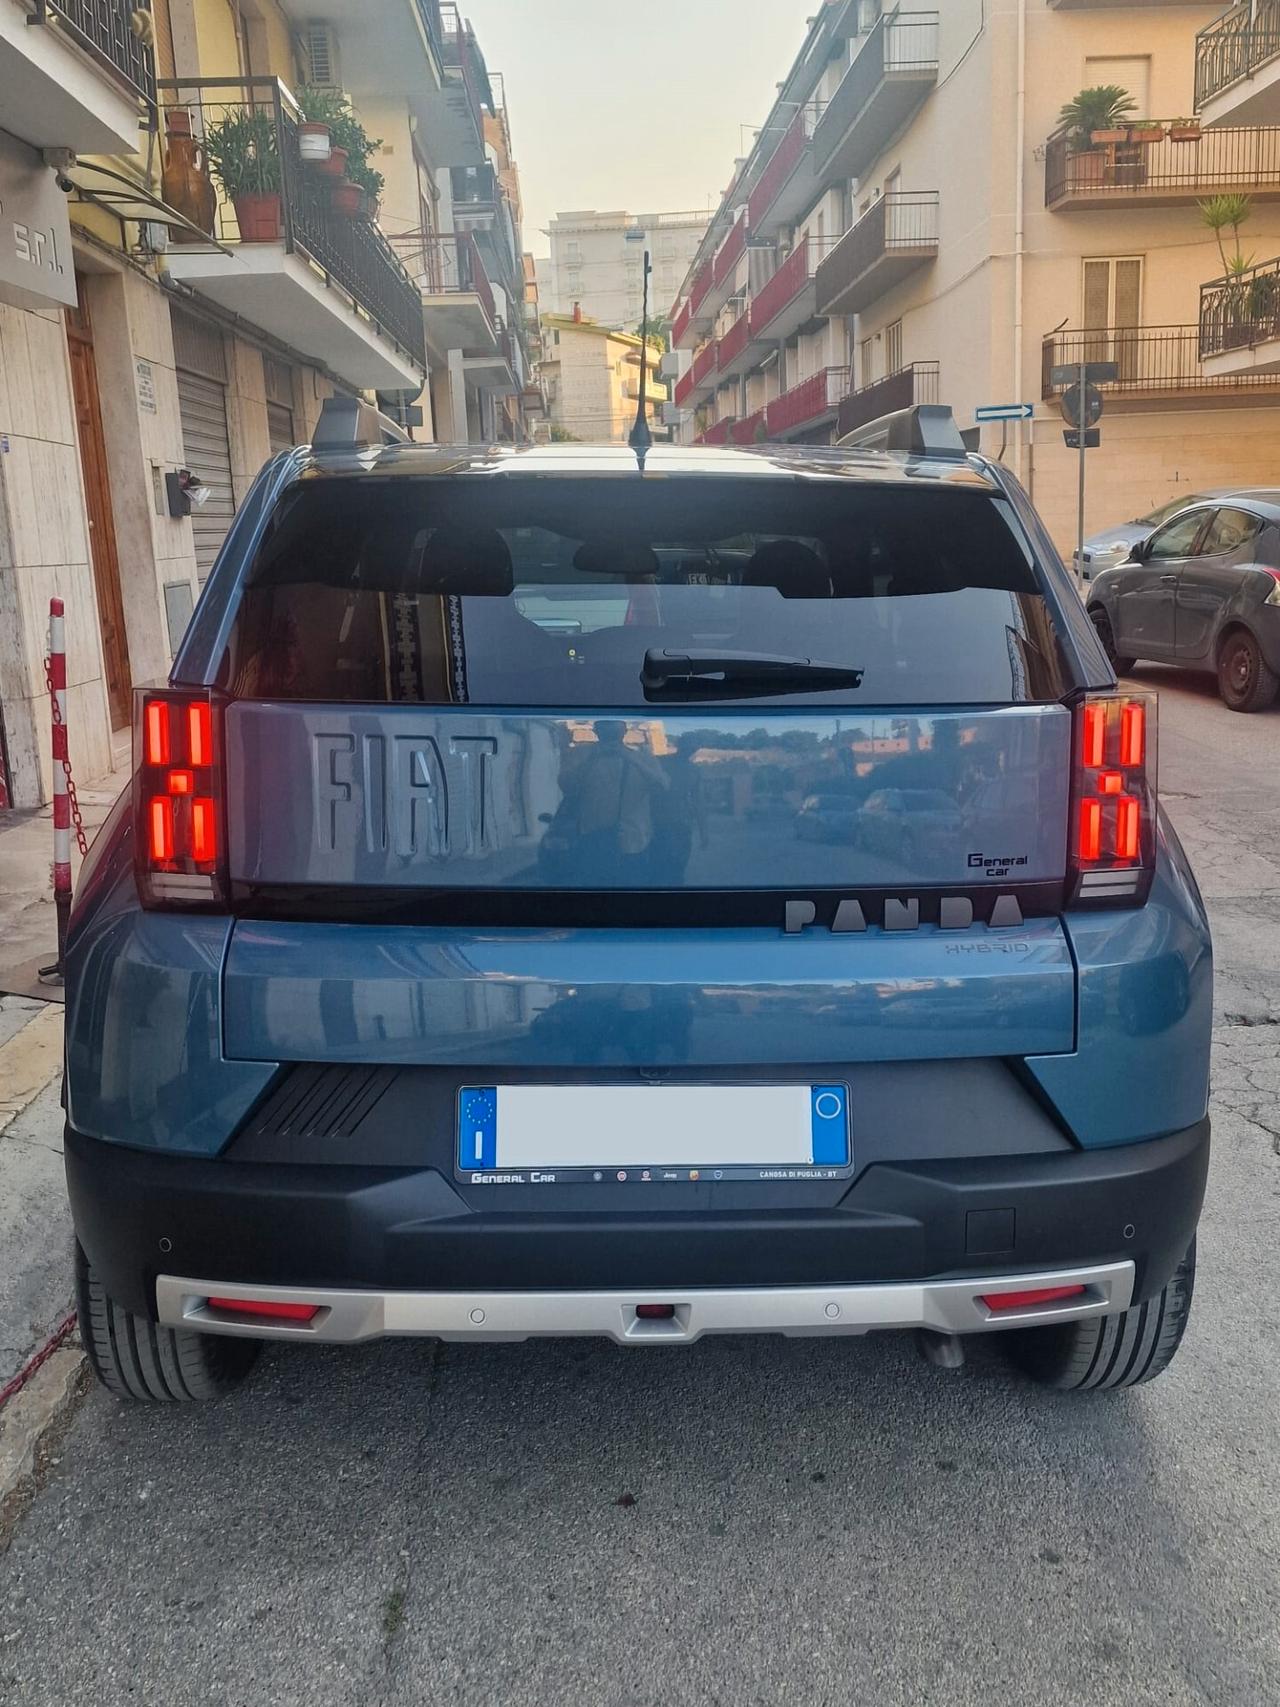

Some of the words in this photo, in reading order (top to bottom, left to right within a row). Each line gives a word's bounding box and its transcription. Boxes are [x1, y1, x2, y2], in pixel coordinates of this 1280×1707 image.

[312, 732, 498, 854] FIAT
[967, 853, 1028, 867] General
[986, 867, 1009, 876] car
[785, 894, 1024, 934] PANDA
[945, 942, 1029, 954] HYBRID
[797, 1170, 822, 1178] PUGLIA
